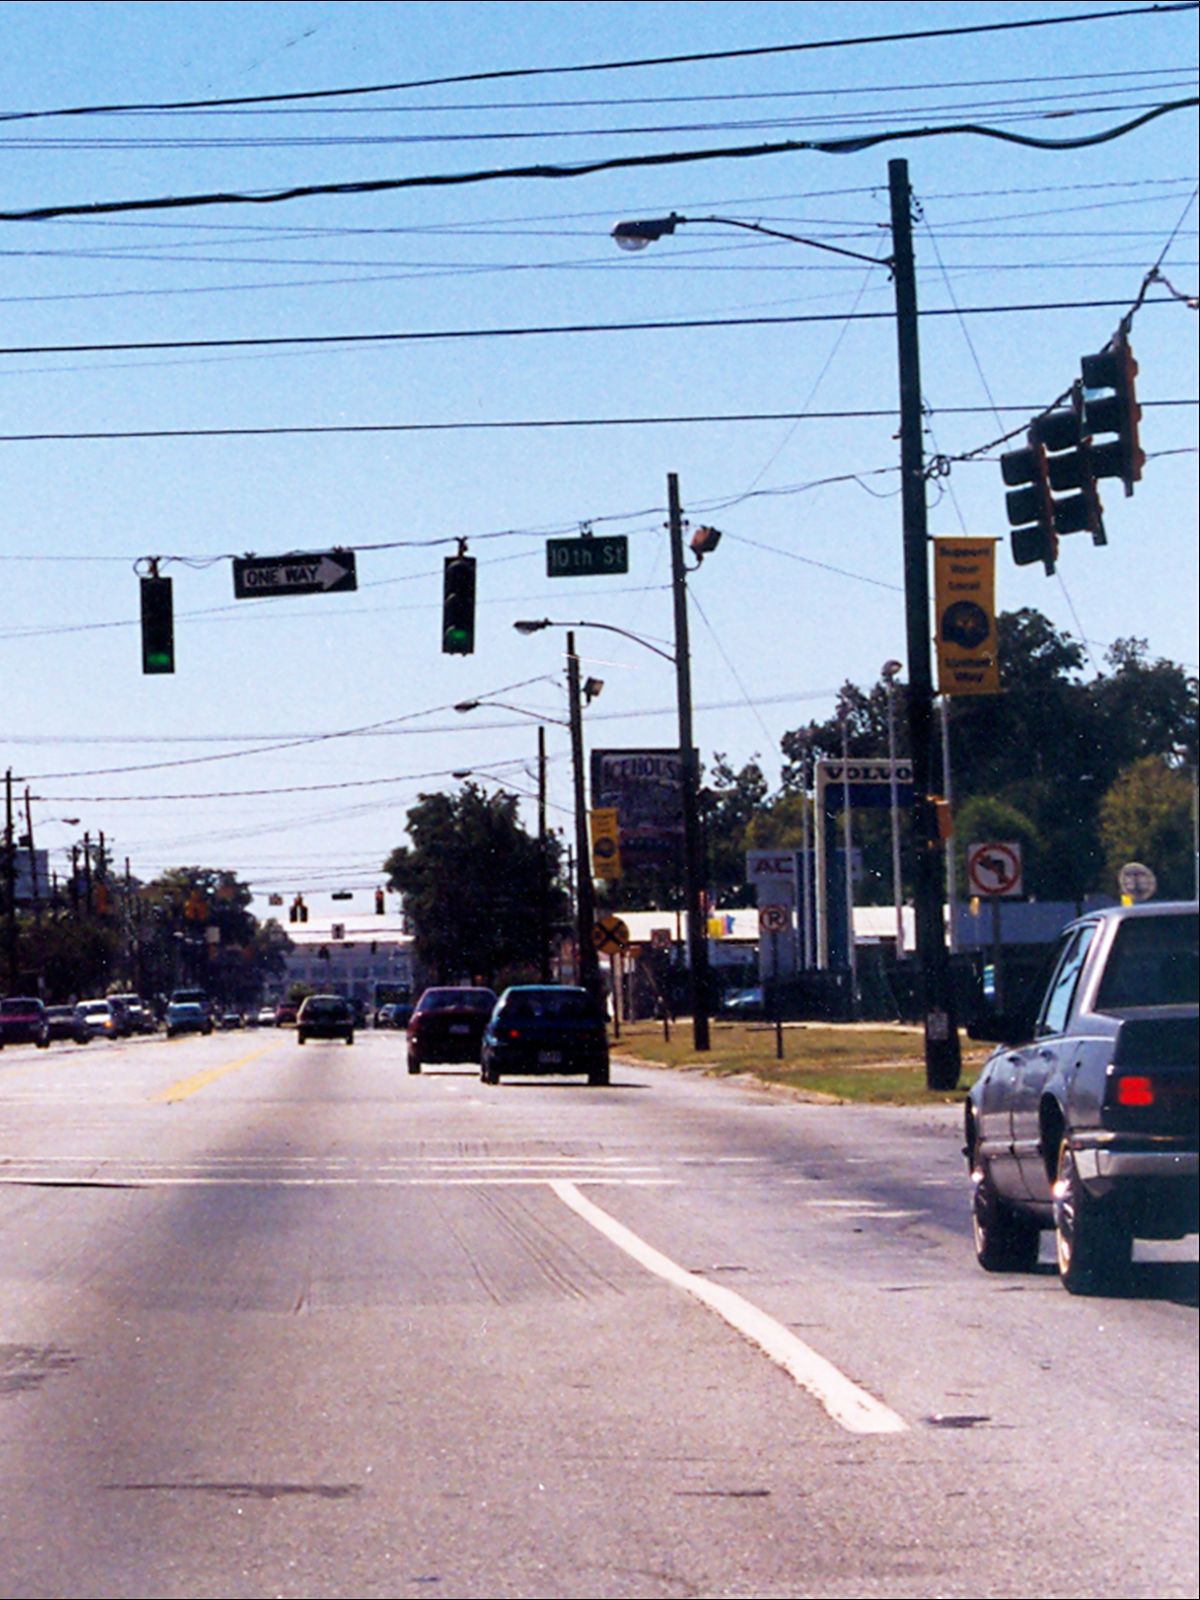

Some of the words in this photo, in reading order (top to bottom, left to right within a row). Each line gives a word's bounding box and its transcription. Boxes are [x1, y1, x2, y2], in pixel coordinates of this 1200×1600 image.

[551, 546, 593, 568] 10th
[603, 544, 626, 565] St
[938, 547, 991, 558] Support
[246, 567, 281, 587] ONE
[285, 564, 319, 583] WAY
[824, 766, 913, 780] VOLVO
